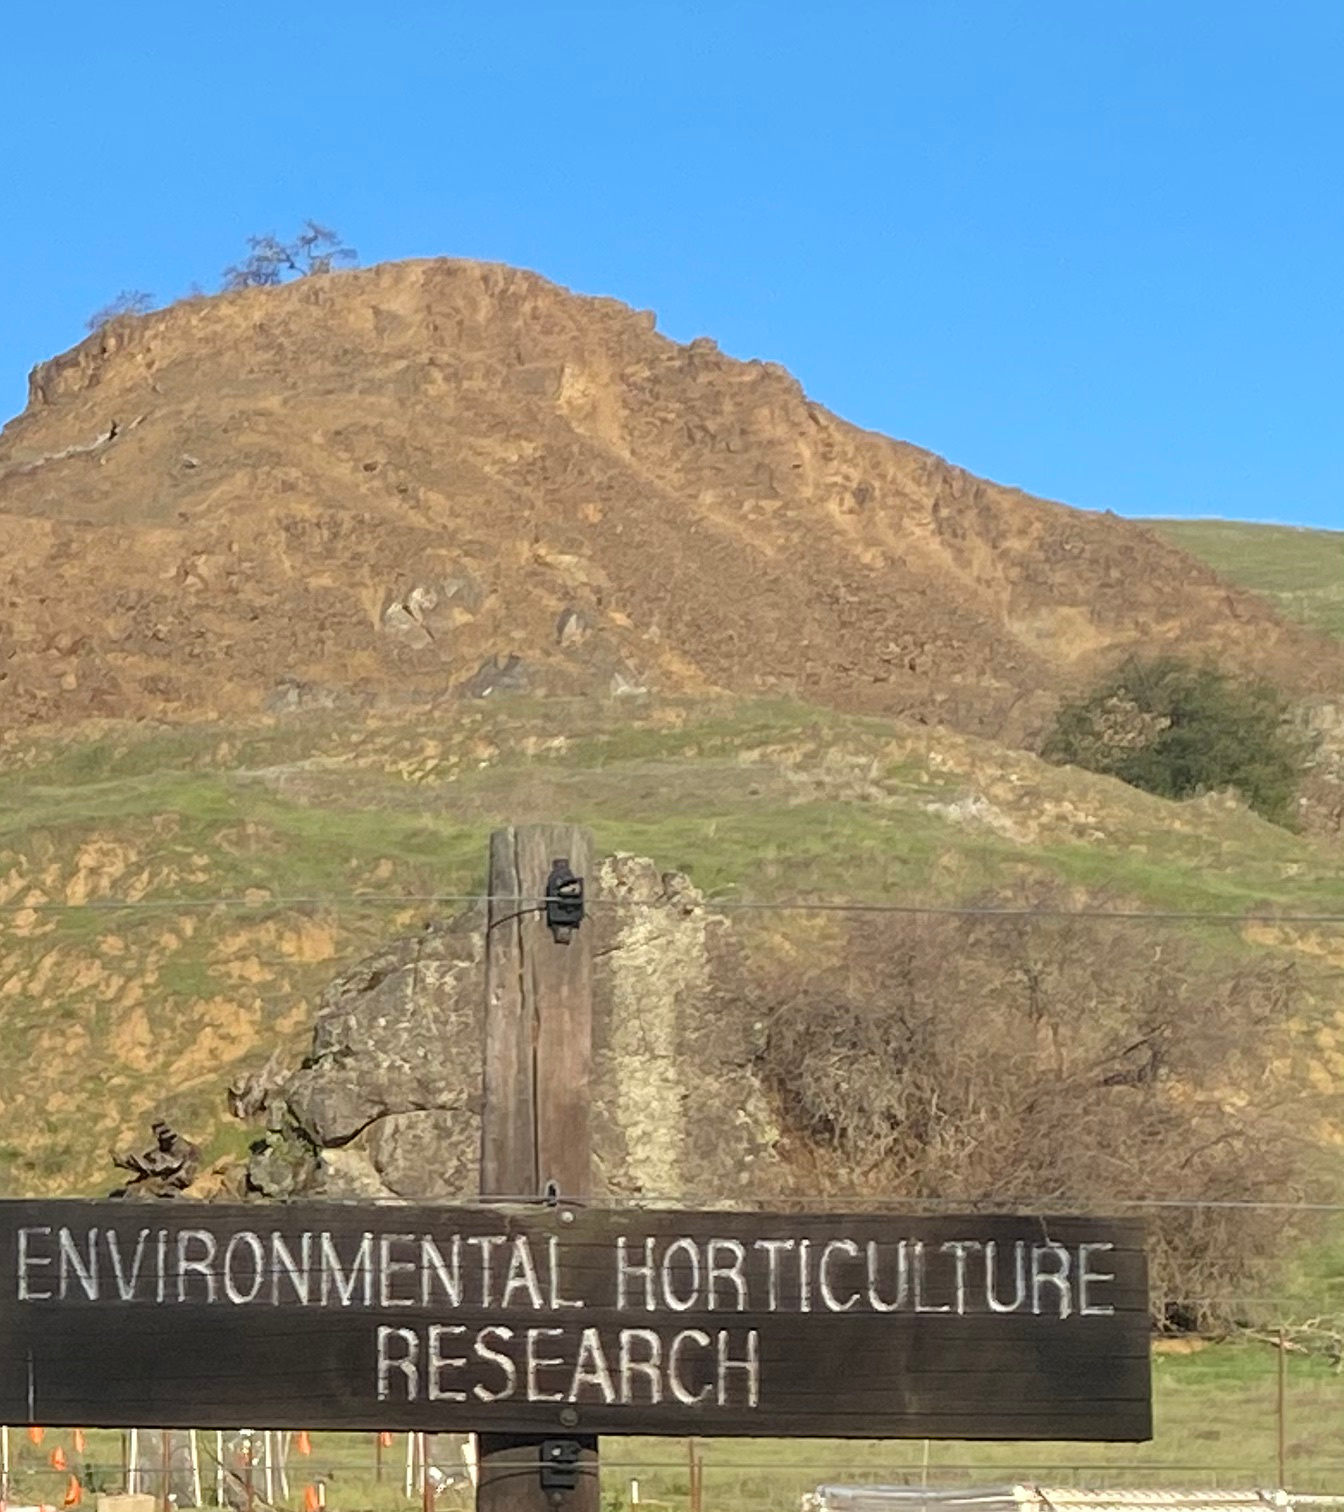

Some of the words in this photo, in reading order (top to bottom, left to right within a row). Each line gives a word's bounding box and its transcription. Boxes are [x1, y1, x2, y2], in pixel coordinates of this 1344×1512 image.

[17, 1227, 584, 1309] ENVIRONMENTAL
[616, 1236, 1115, 1319] HORTICULTURE
[376, 1325, 760, 1407] RESEARCH
